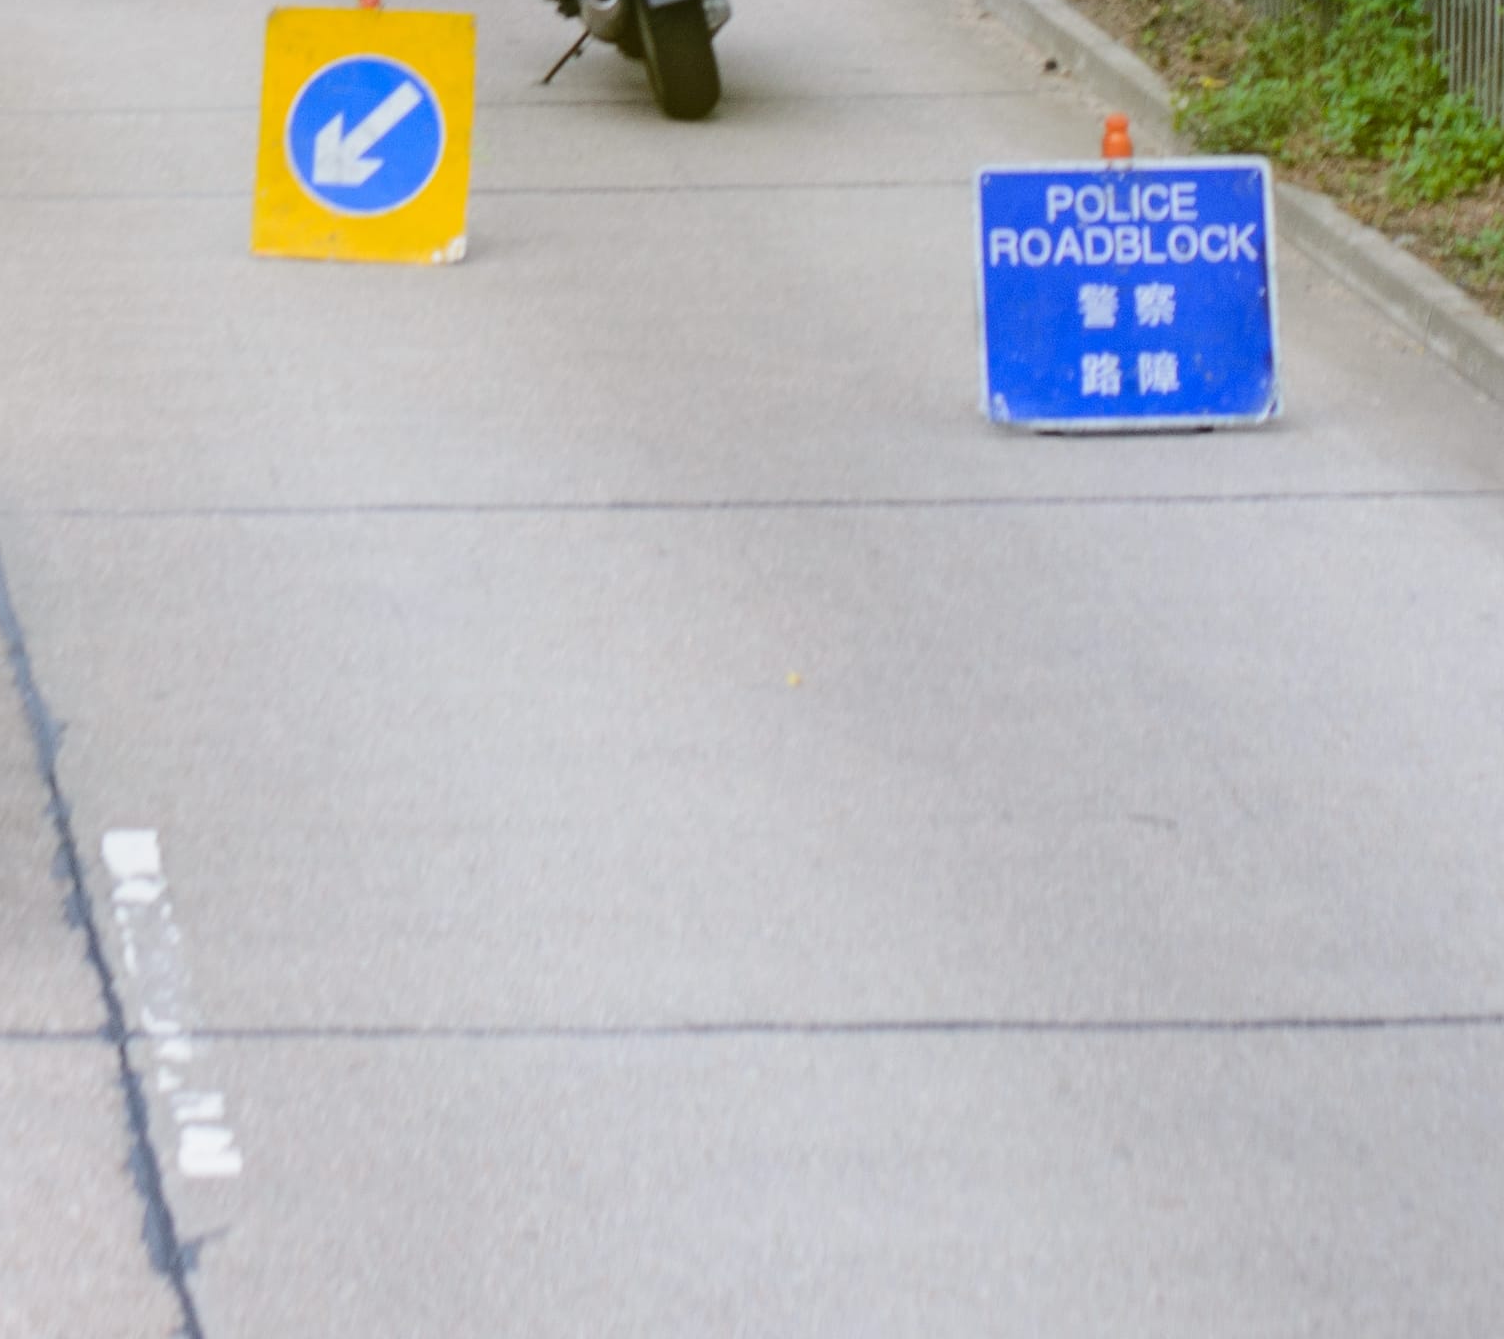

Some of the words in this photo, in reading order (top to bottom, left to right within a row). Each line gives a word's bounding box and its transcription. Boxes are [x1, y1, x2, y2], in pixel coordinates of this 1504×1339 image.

[1045, 181, 1199, 224] POLICE
[989, 223, 1258, 267] ROADBLOCK
[1078, 282, 1177, 329] 警察
[1081, 350, 1180, 397] 路障
